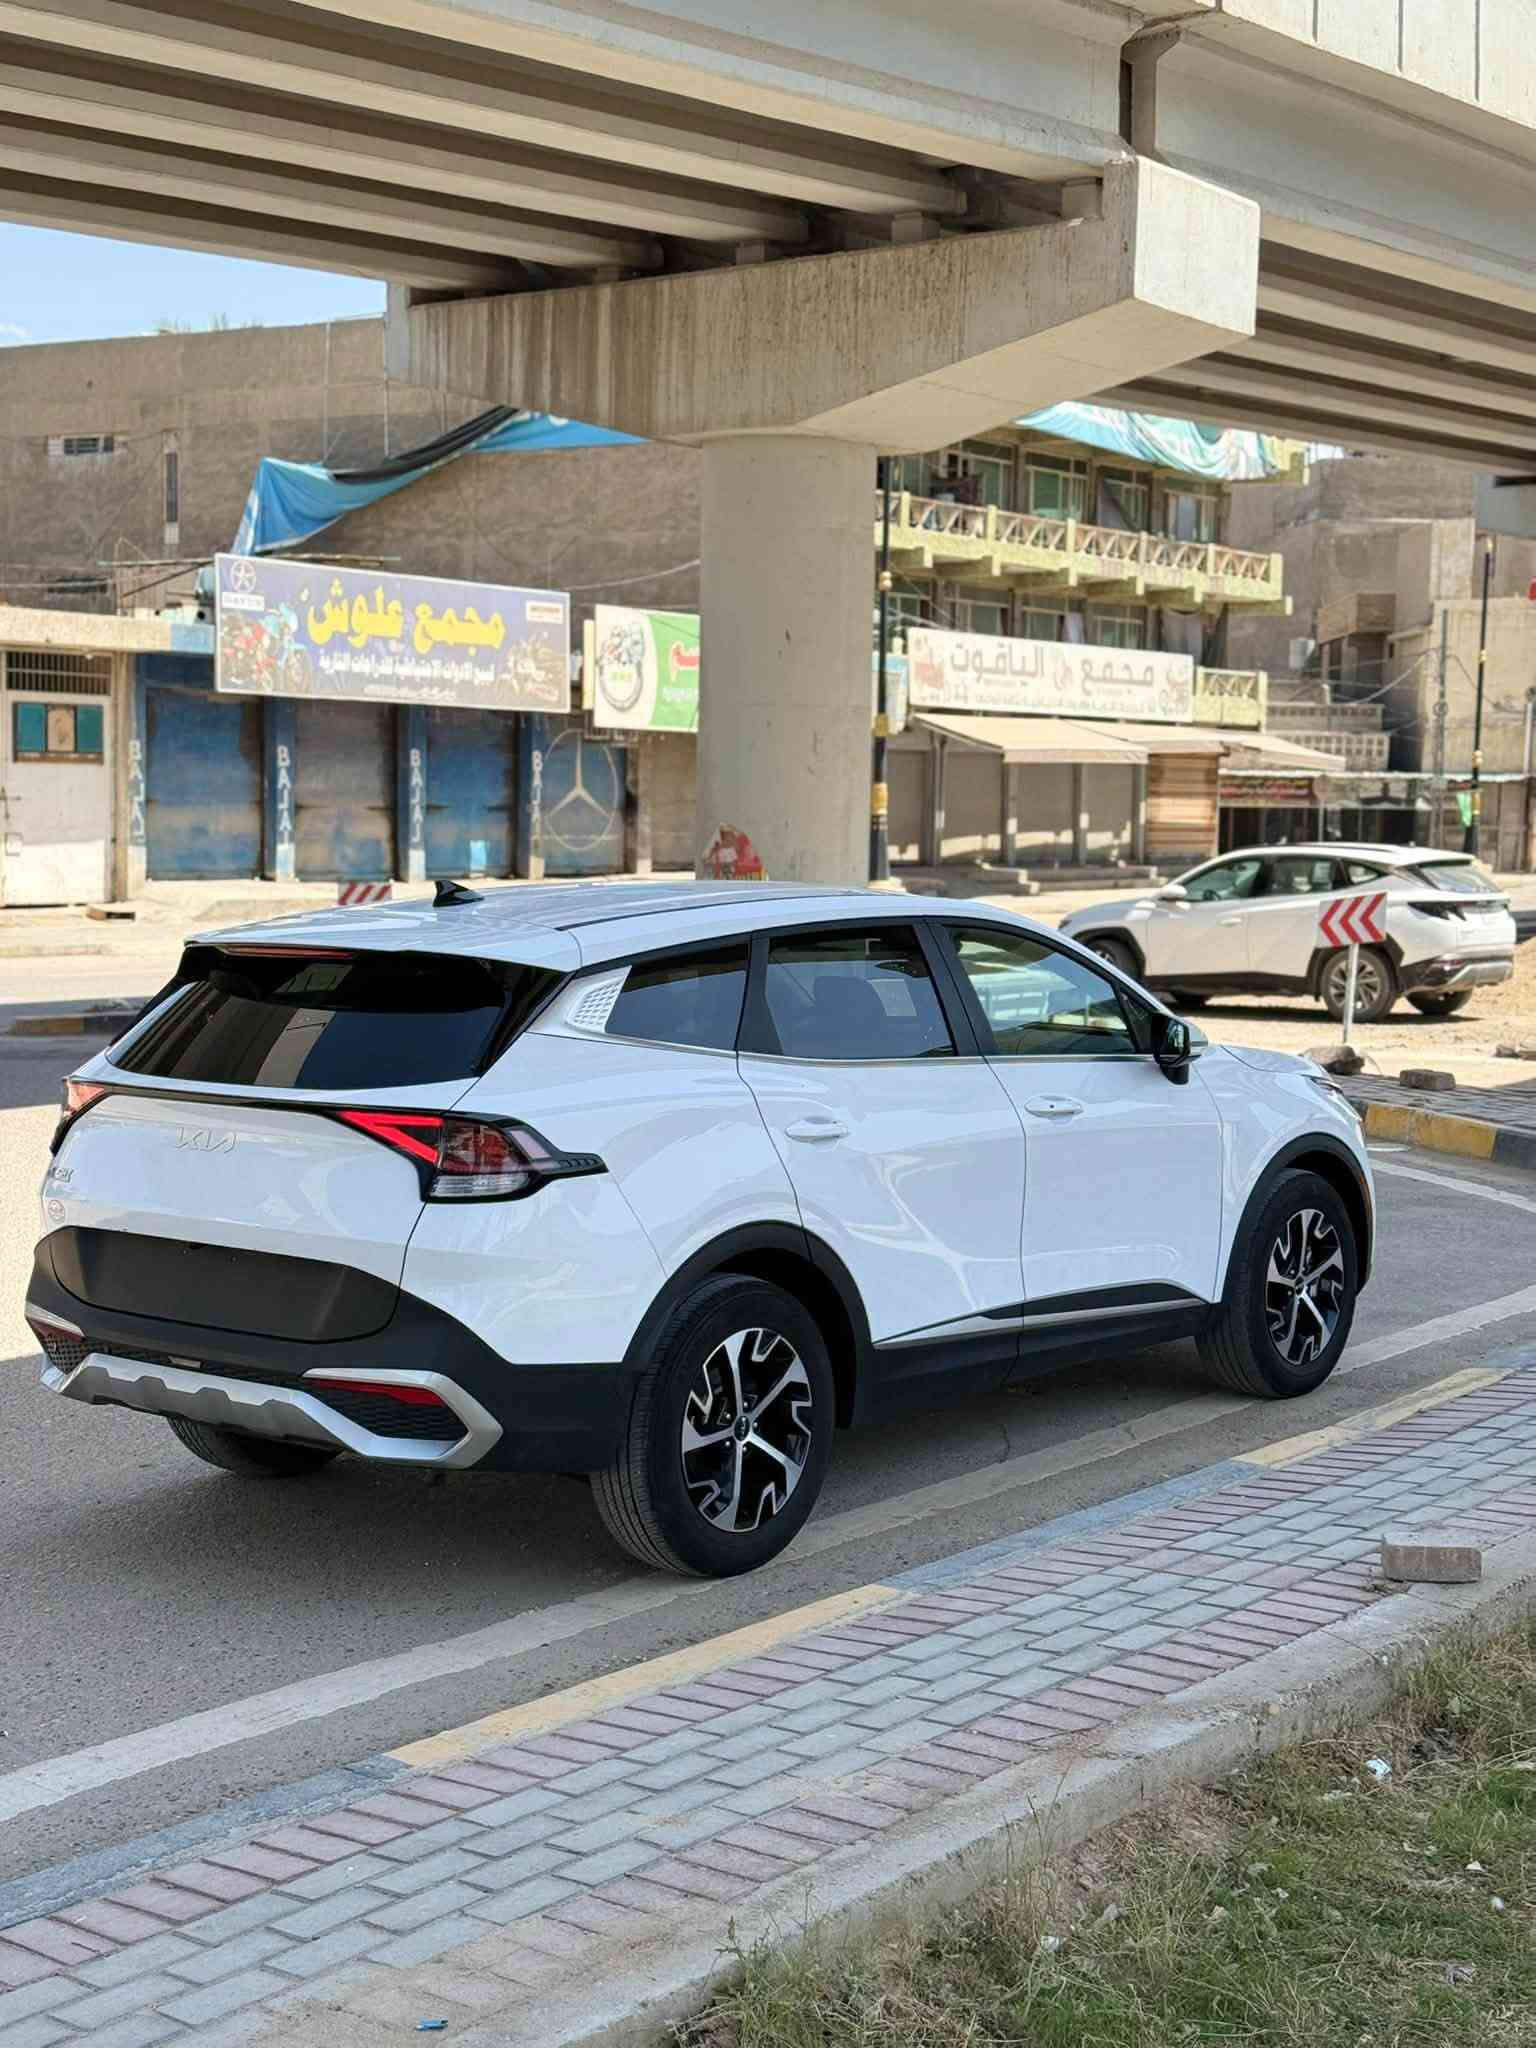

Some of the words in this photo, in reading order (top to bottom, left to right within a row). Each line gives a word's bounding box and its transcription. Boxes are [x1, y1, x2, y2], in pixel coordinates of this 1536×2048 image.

[307, 577, 404, 648] علوش
[414, 602, 505, 656] مجمع
[950, 642, 1043, 686] الياقوت
[1080, 657, 1154, 694] مجمع
[409, 748, 424, 842] BAJAJ
